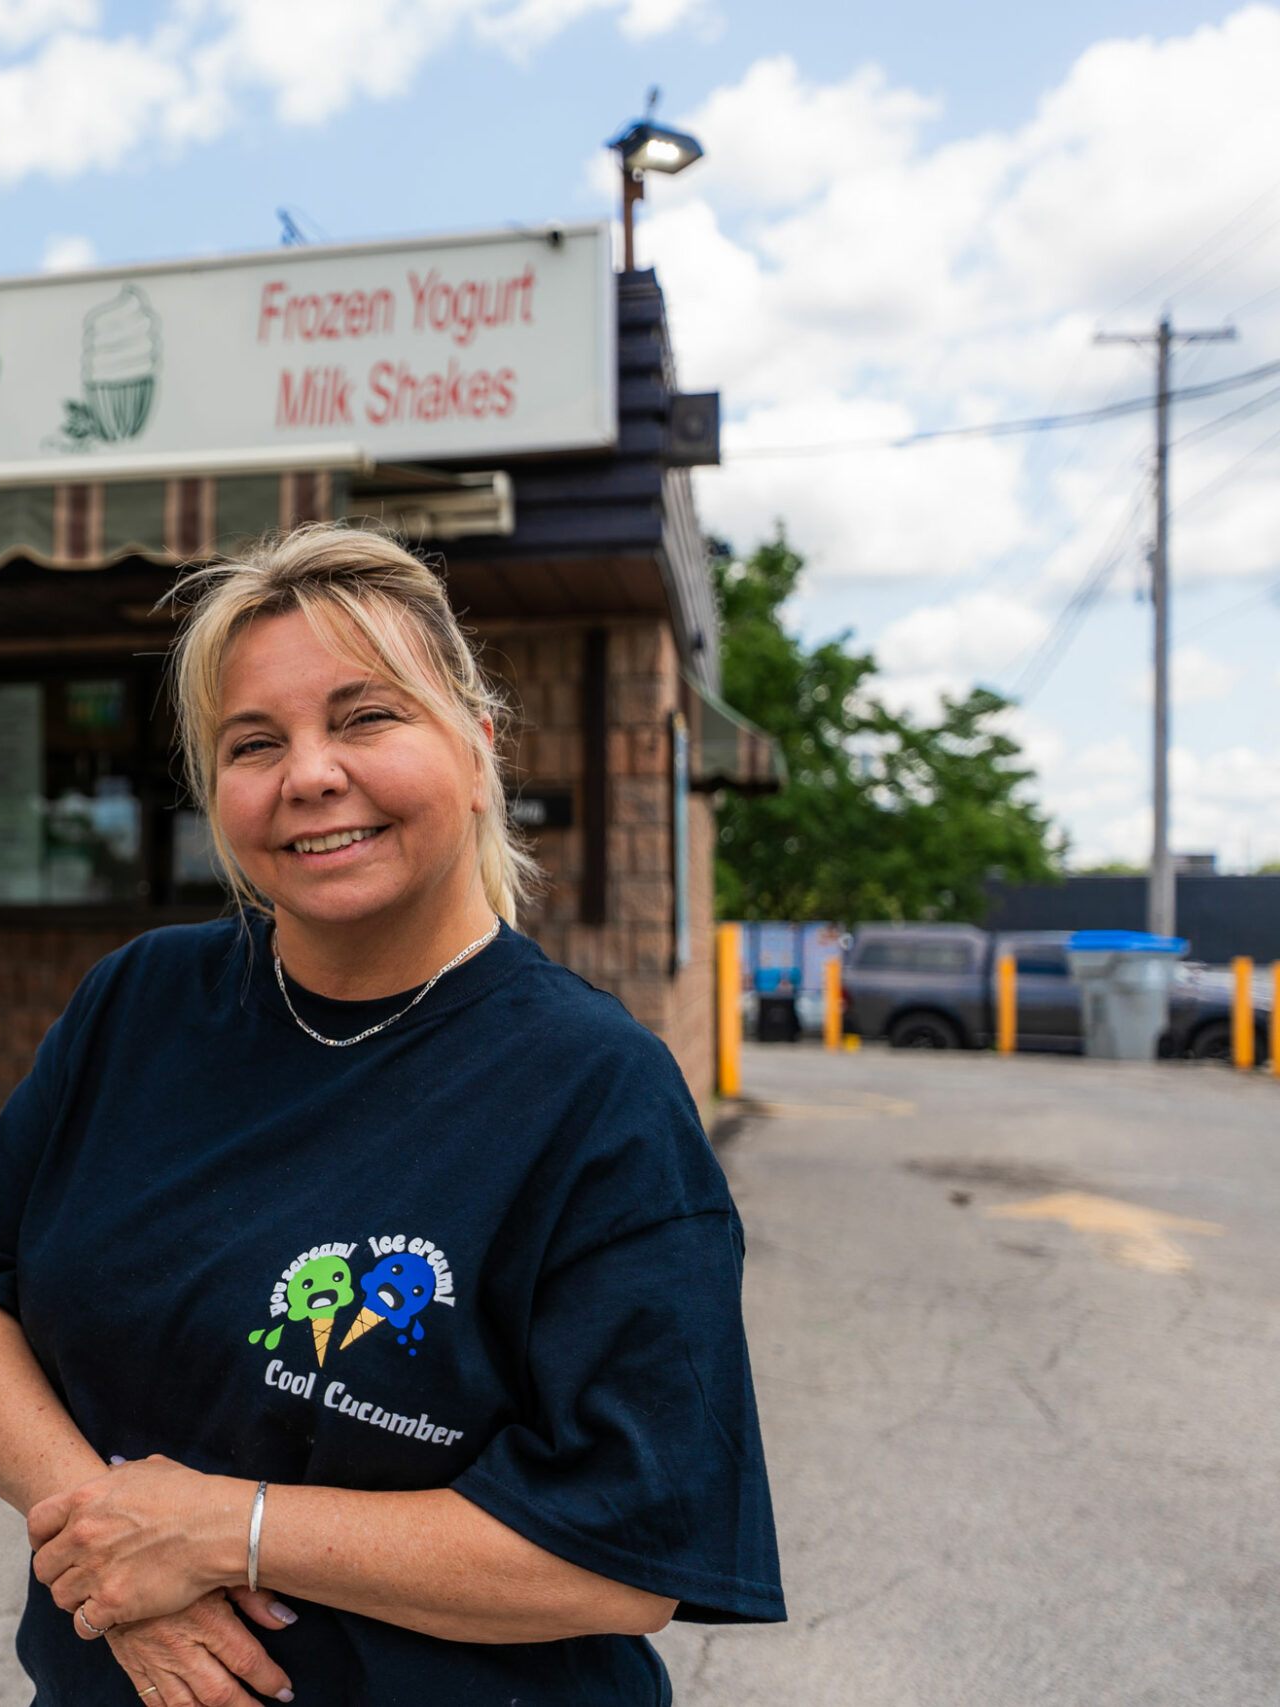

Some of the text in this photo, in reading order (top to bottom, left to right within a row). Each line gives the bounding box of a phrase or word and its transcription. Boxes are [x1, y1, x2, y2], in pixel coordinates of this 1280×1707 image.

[258, 264, 535, 347] Frozen Yogurt
[275, 358, 517, 427] Milk Shakes
[269, 1282, 289, 1318] you
[265, 1359, 464, 1446] Cool Cucumber
